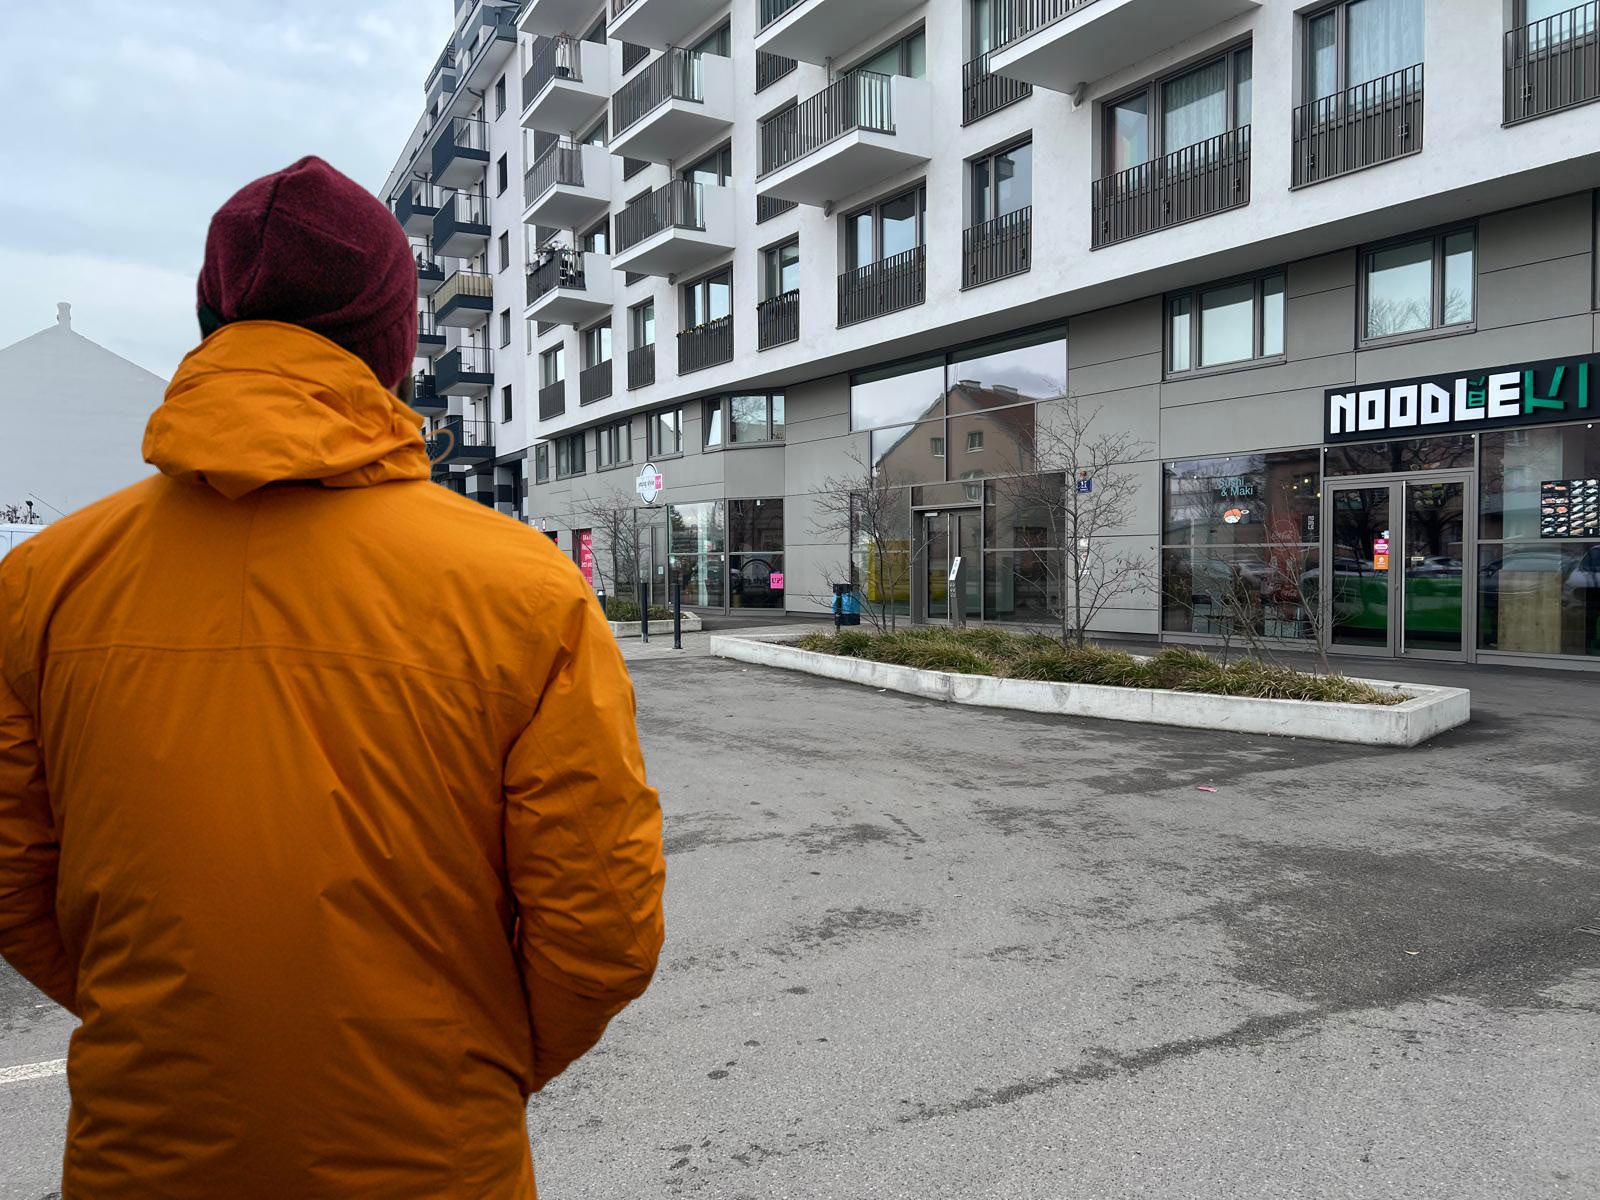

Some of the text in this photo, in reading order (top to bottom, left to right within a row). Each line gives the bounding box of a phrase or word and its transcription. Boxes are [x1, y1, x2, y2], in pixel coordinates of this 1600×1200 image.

[1219, 477, 1245, 488] Sushi
[1221, 485, 1253, 496] & Maki
